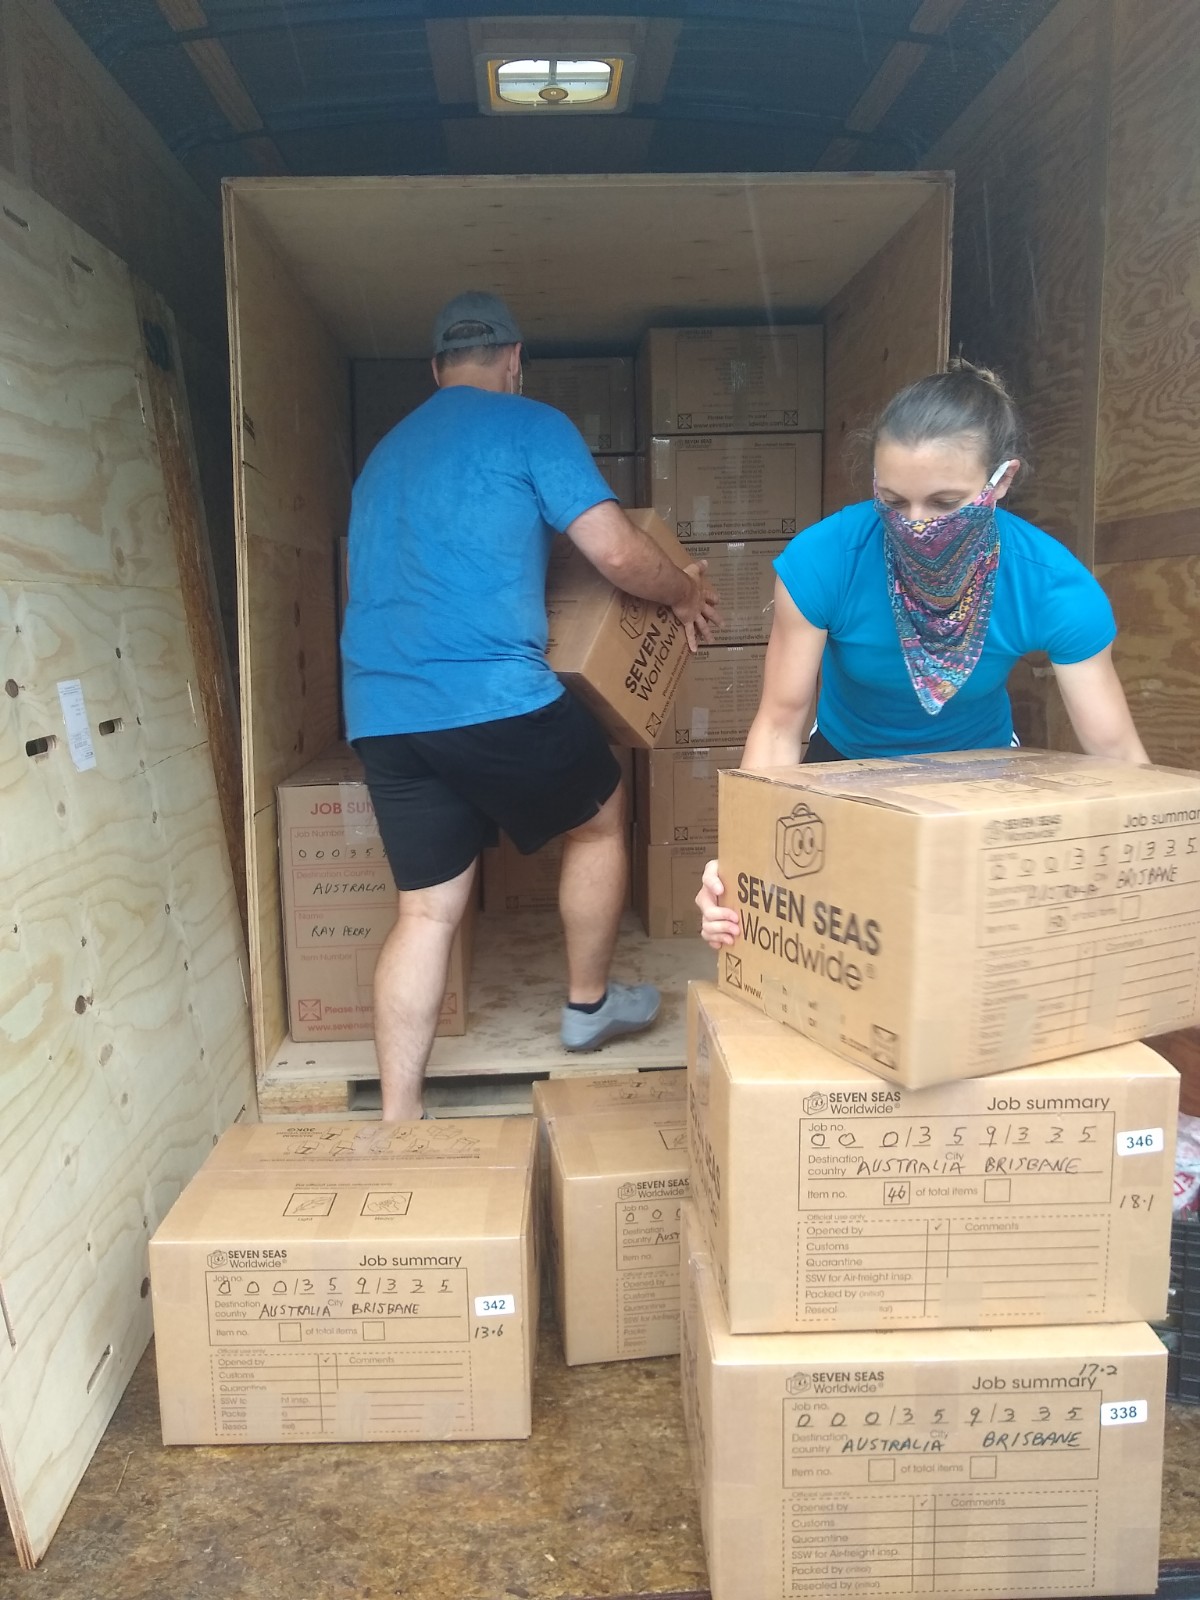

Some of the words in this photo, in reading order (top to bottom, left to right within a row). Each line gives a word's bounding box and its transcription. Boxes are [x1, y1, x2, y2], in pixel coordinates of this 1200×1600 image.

[625, 623, 661, 693] SEVEN
[311, 802, 343, 815] JOB
[1123, 813, 1149, 828] Job
[1151, 808, 1200, 826] summar
[313, 882, 386, 895] AUSTRALIA
[737, 872, 805, 928] SEVEN
[813, 900, 882, 956] SEAS
[311, 926, 335, 938] RAY
[343, 925, 371, 938] PERRY
[324, 1005, 353, 1014] Please
[829, 1092, 868, 1103] SEVEN
[871, 1091, 901, 1102] SEAS
[987, 1096, 1021, 1111] Job
[1026, 1097, 1110, 1111] summary
[808, 1123, 828, 1132] Job
[1126, 1135, 1154, 1150] 346
[808, 1154, 864, 1164] Destination
[945, 1151, 964, 1162] City
[857, 1158, 967, 1176] AUSTRALIA
[985, 1156, 1082, 1175] BRISBANE
[808, 1167, 847, 1177] country
[637, 1180, 665, 1190] SEVEN
[667, 1178, 689, 1188] SEAS
[808, 1190, 829, 1199] Item
[915, 1188, 926, 1197] of
[928, 1187, 945, 1196] total
[947, 1187, 978, 1196] items
[622, 1204, 637, 1212] Job
[806, 1226, 849, 1236] Opened
[851, 1226, 863, 1236] by
[965, 1221, 1020, 1231] Comments
[806, 1242, 849, 1251] Customs
[228, 1250, 261, 1259] SEVEN
[262, 1249, 287, 1259] SEAS
[359, 1255, 387, 1267] Job
[392, 1255, 462, 1268] summary
[806, 1258, 863, 1267] Quarantine
[805, 1273, 827, 1283] SSW
[828, 1273, 842, 1282] for
[805, 1290, 843, 1299] Packed
[845, 1289, 857, 1299] by
[214, 1300, 261, 1308] Destination
[327, 1299, 343, 1308] City
[482, 1300, 506, 1311] 342
[215, 1310, 247, 1319] country
[259, 1304, 331, 1319] AUSTRALIA
[352, 1302, 420, 1315] BRISBANE
[805, 1306, 838, 1314] Reseal
[216, 1329, 234, 1337] Item
[218, 1358, 253, 1367] Opened
[255, 1358, 265, 1367] by
[349, 1356, 395, 1365] Comments
[218, 1371, 255, 1380] Customs
[812, 1372, 851, 1383] SEVEN
[854, 1371, 885, 1382] SEAS
[972, 1376, 1006, 1390] Job
[1012, 1376, 1097, 1391] summary
[792, 1402, 812, 1412] Job
[221, 1410, 247, 1418] Packe
[1109, 1405, 1138, 1420] 338
[792, 1433, 848, 1443] Destination
[929, 1429, 949, 1440] City
[842, 1437, 945, 1453] AUSTRALIA
[982, 1431, 1082, 1451] BRISBANE
[792, 1445, 831, 1455] country
[792, 1468, 813, 1477] Item
[901, 1465, 912, 1474] of
[913, 1464, 932, 1474] total
[934, 1464, 964, 1473] items
[792, 1503, 834, 1513] Opened
[836, 1503, 849, 1513] by
[950, 1498, 1005, 1508] Comments
[792, 1519, 835, 1528] Customs
[792, 1534, 849, 1544] Quarantine
[792, 1550, 813, 1560] SSW
[815, 1550, 828, 1559] for
[791, 1566, 829, 1575] Packed
[830, 1565, 843, 1576] by
[840, 1581, 851, 1590] by
